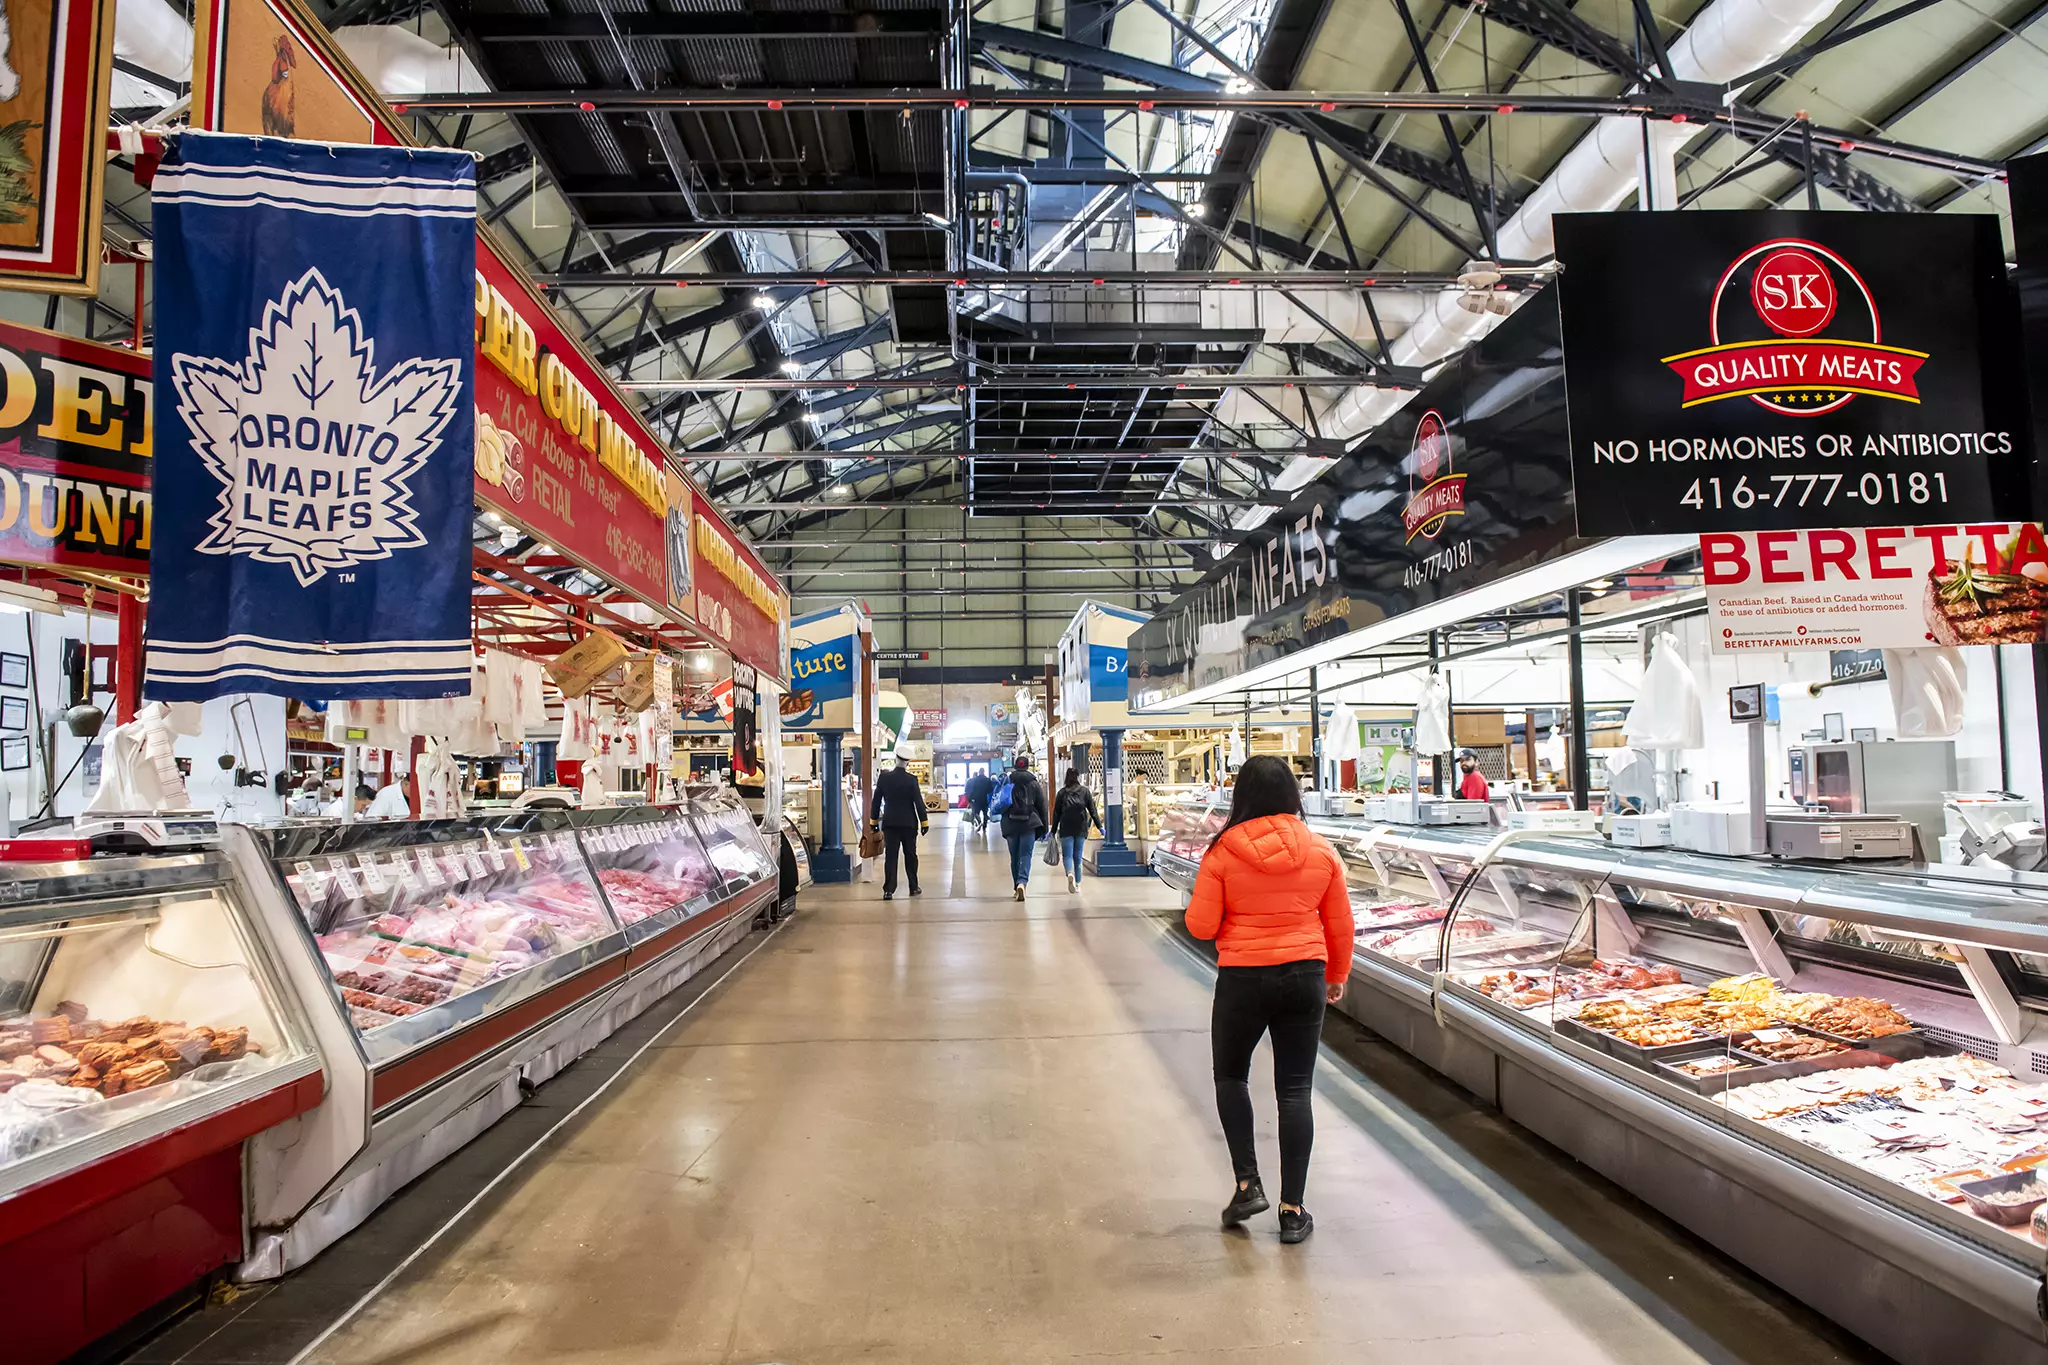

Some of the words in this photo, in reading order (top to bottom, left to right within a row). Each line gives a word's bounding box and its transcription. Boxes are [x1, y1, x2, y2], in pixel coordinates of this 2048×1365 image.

[1762, 273, 1826, 310] SK
[1694, 354, 1808, 387] QUALITY
[1819, 354, 1901, 385] MEATS
[229, 414, 399, 465] ORONTO
[515, 403, 537, 448] Cut
[541, 428, 575, 479] Above
[579, 458, 595, 496] The
[539, 352, 599, 453] CUT
[598, 408, 668, 519] MEATS
[1420, 432, 1438, 467] SK
[1593, 439, 1639, 464] NO
[1649, 434, 1805, 463] HORMONES
[1816, 434, 1853, 458] OR
[1862, 431, 2012, 457] ANTIBIOTICS
[246, 458, 372, 499] MAPLE
[532, 463, 576, 528] RETAIL
[1680, 471, 1948, 510] 416-777-0181
[243, 493, 372, 531] LEAFS
[1405, 494, 1435, 531] QUALITY
[1435, 485, 1460, 510] MEATS
[1251, 503, 1327, 620] MEATS
[1403, 538, 1473, 589] 416-777-0181
[1699, 523, 2048, 586] BERETTA
[338, 573, 355, 583] TM
[1719, 598, 1762, 607] Canadian
[1764, 596, 1786, 605] Beef.
[1791, 595, 1821, 604] Raised
[1823, 595, 1831, 603] in
[1833, 594, 1868, 603] Canada
[1870, 593, 1903, 601] without
[1720, 608, 1735, 616] the
[1755, 607, 1765, 616] of
[1766, 606, 1814, 615] antibiotics
[1828, 604, 1858, 613] added
[1859, 602, 1907, 612] hormones.
[1724, 636, 1862, 649] BERETTAFAMILYFARMS.COM
[790, 652, 846, 679] ture
